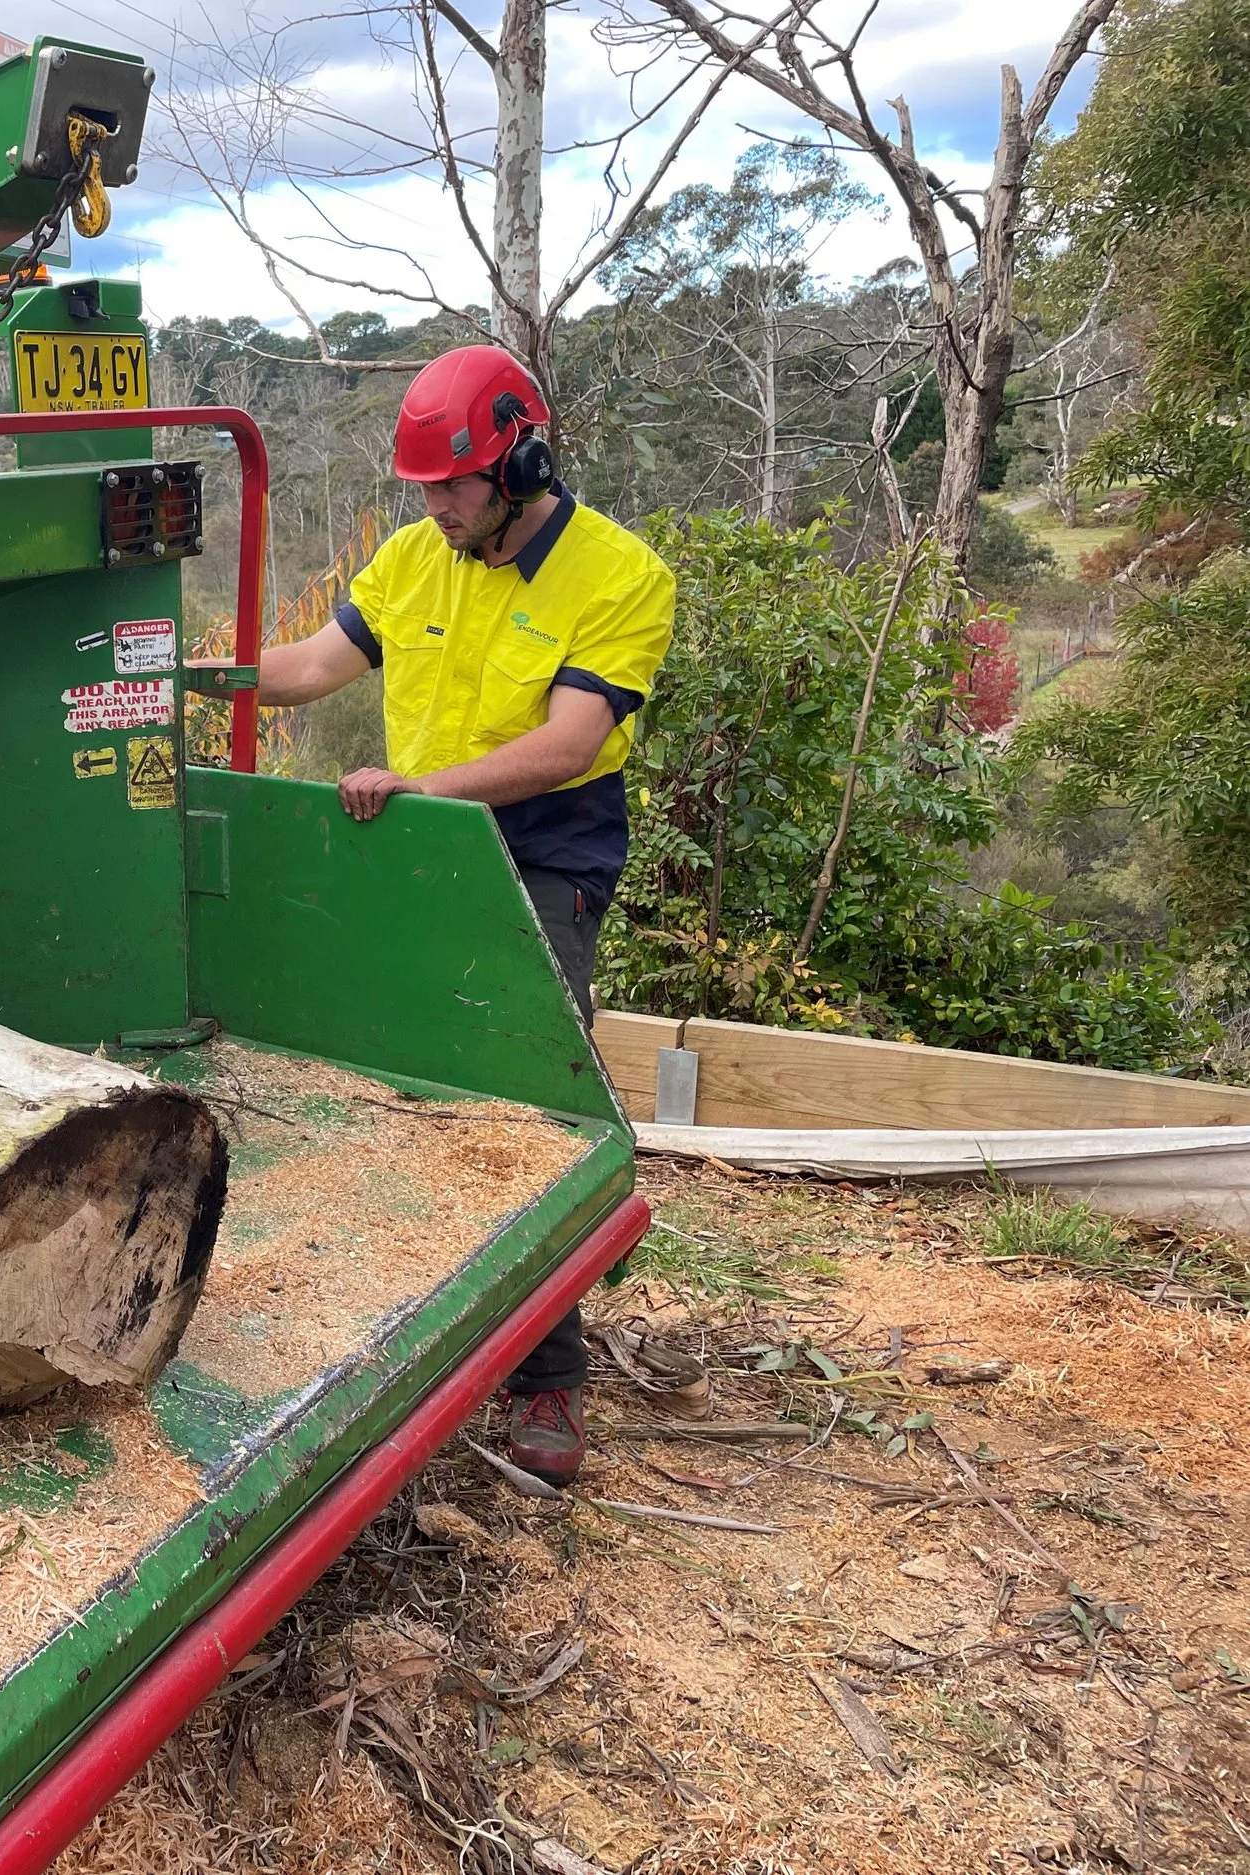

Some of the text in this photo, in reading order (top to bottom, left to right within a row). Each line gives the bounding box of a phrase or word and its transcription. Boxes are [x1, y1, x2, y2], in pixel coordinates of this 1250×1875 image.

[131, 624, 169, 634] DANGER
[518, 624, 559, 644] ENDEAVOUR
[70, 680, 164, 698] DO NOT
[77, 695, 158, 708] REACH INTO
[68, 705, 170, 720] THIS AREA FOR
[77, 721, 103, 731] ANY
